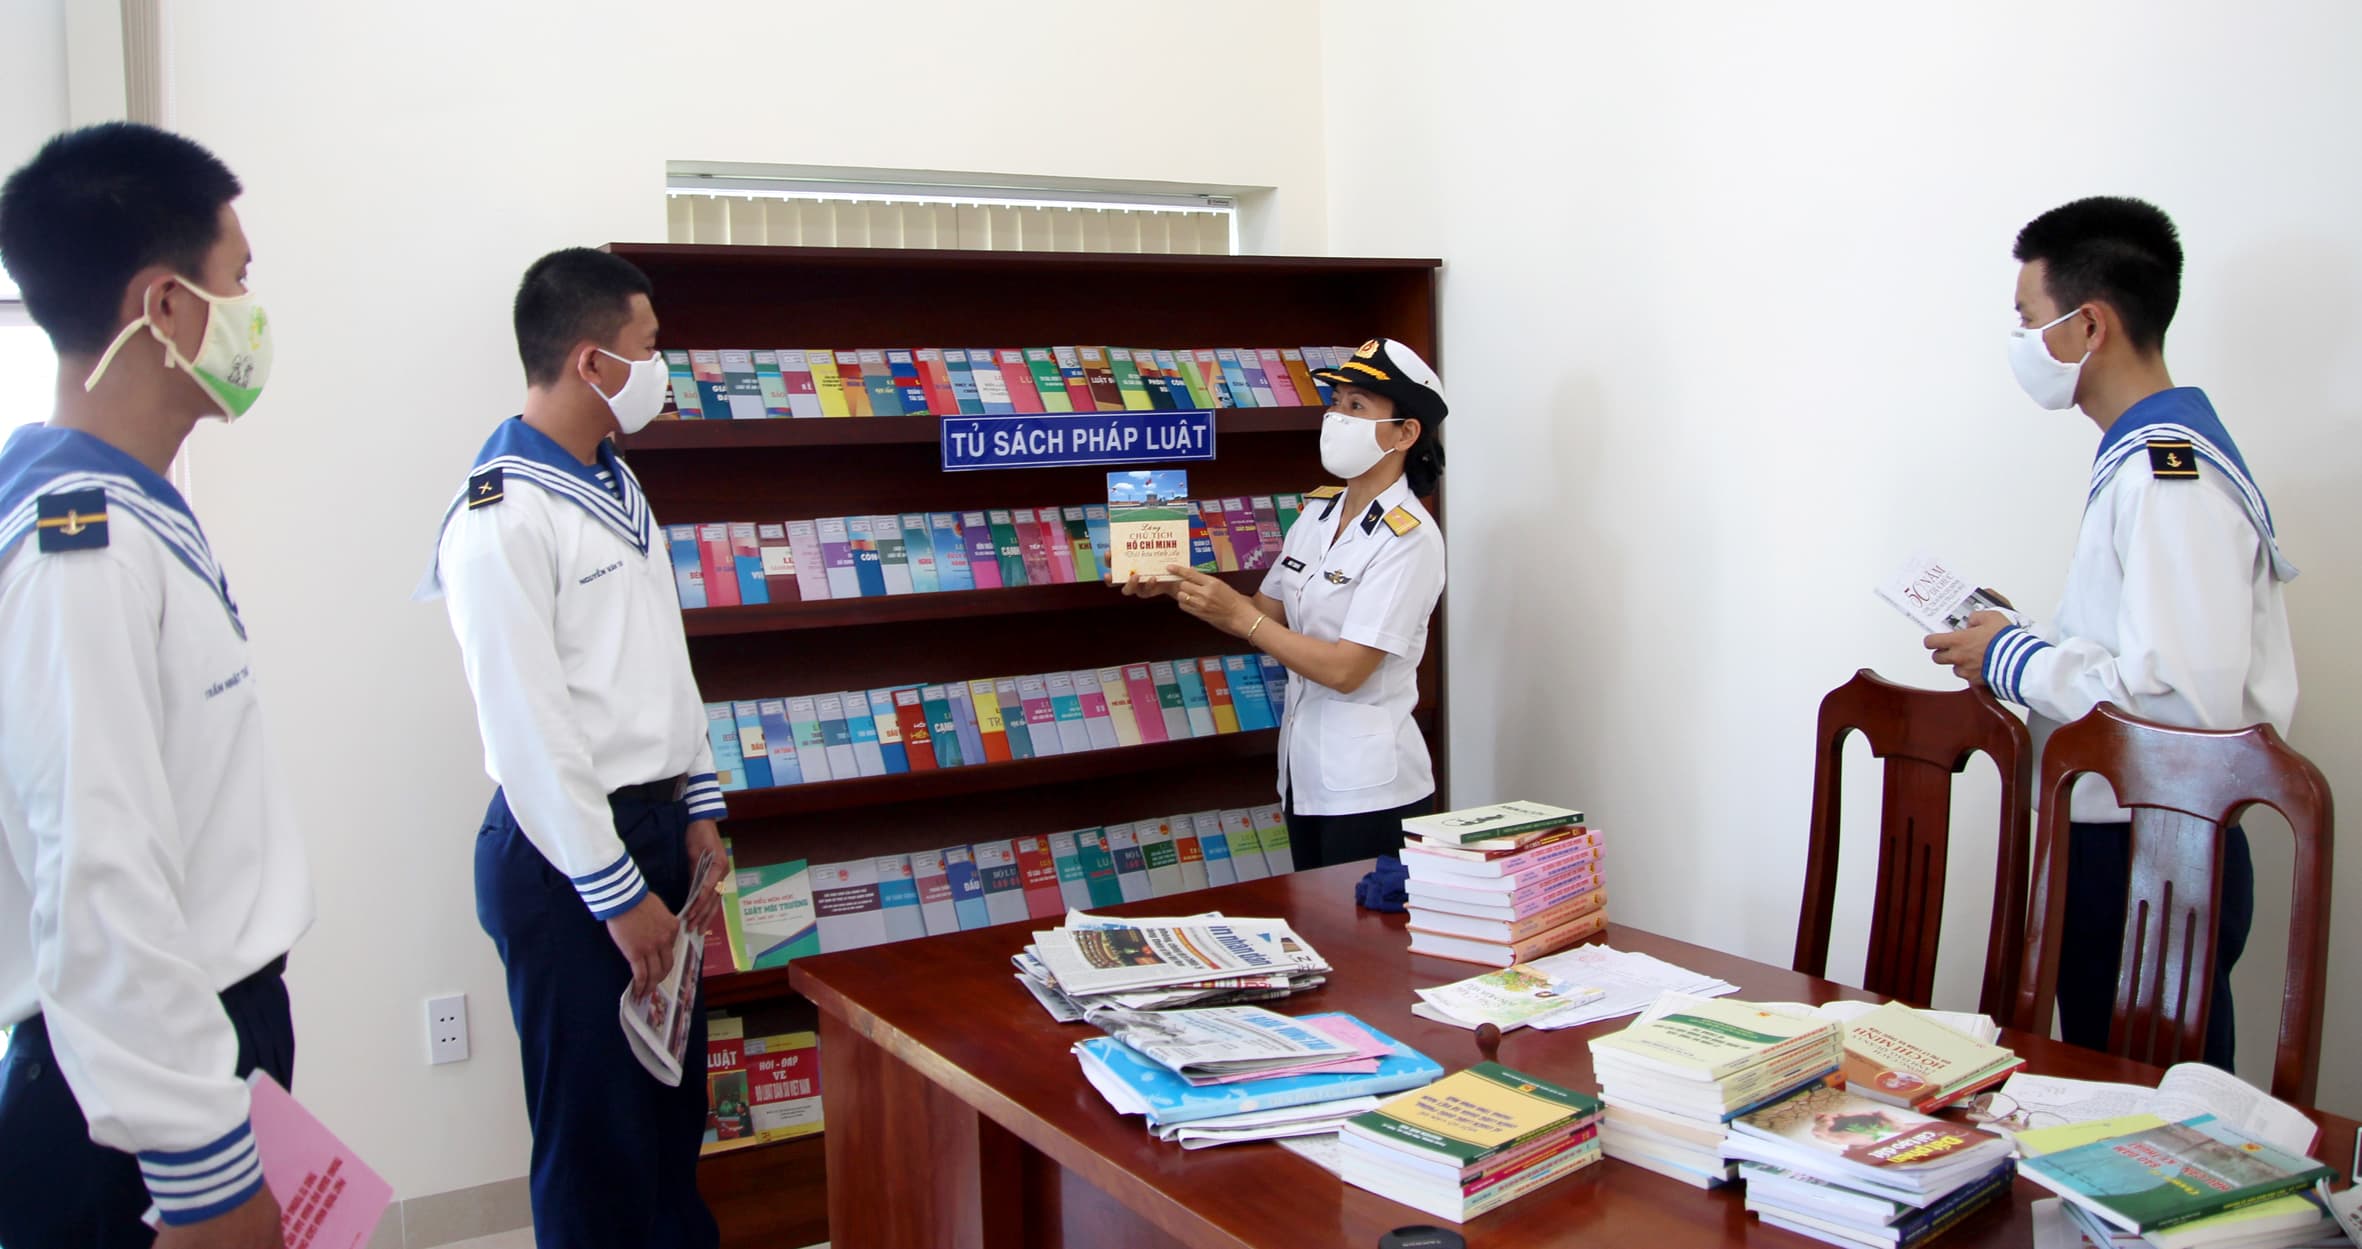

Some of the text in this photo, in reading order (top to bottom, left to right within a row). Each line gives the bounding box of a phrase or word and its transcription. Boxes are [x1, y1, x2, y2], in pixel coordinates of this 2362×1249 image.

[951, 422, 1206, 456] TỦ SÁCH PHÁP LUẬT
[1126, 539, 1177, 550] HỒ CHÍ MINH
[1852, 1026, 1894, 1047] MINH
[707, 1049, 737, 1069] LUẬT
